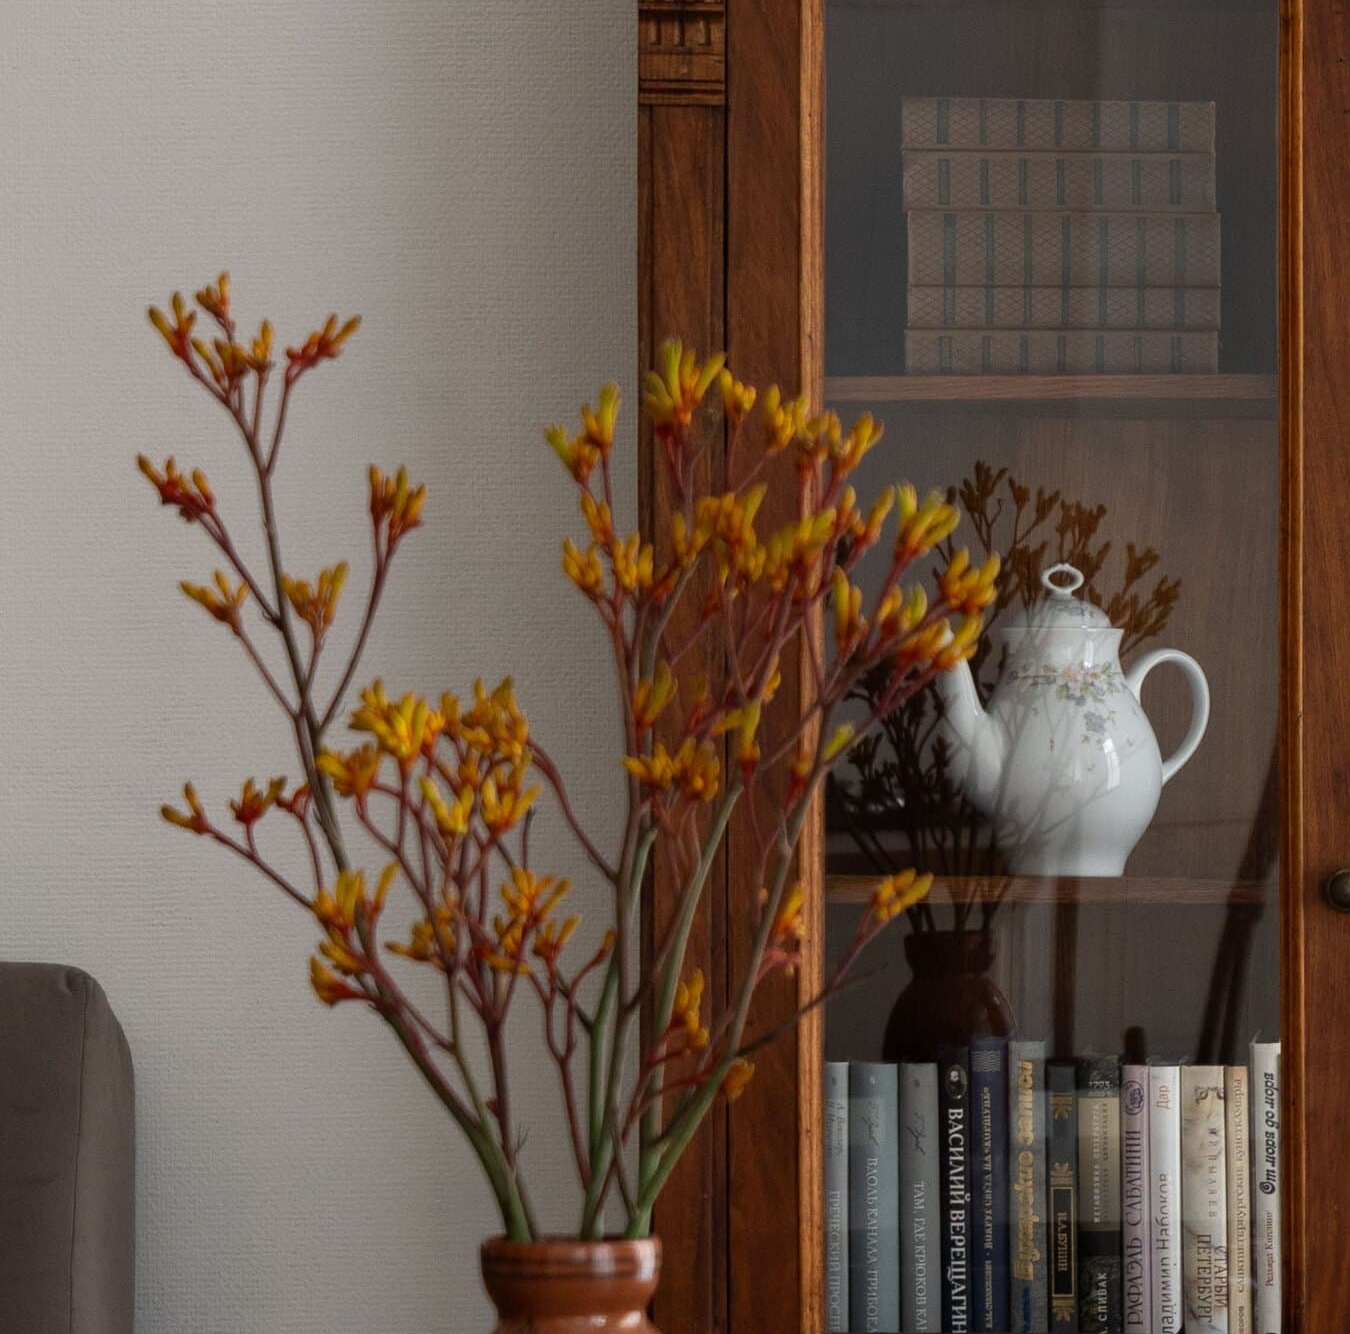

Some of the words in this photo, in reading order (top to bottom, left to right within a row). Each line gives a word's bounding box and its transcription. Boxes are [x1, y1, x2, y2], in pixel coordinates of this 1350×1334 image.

[1155, 1085, 1172, 1111] Дар
[1261, 1071, 1276, 1110] моря
[1262, 1111, 1279, 1129] до
[1262, 1130, 1276, 1168] моря
[866, 1156, 880, 1205] ВДОЛЬ
[947, 1107, 972, 1205] ВАСИЛИЙ
[1124, 1129, 1143, 1227] САБАТИНИ
[911, 1179, 926, 1214] ТАМ,
[1155, 1173, 1172, 1252] Набоков
[828, 1189, 842, 1271] ГРЕЧЕСКИЙ
[866, 1207, 879, 1265] КАНАЛА
[913, 1217, 926, 1242] ГДЕ
[914, 1244, 927, 1305] КРЮКОВ
[946, 1209, 968, 1334] ВЕРЕЩАГИН
[1097, 1273, 1108, 1322] СПИВАК
[1127, 1237, 1144, 1327] РАФАЭЛЬ
[1195, 1234, 1213, 1324] ПЕТЕРБУРГ
